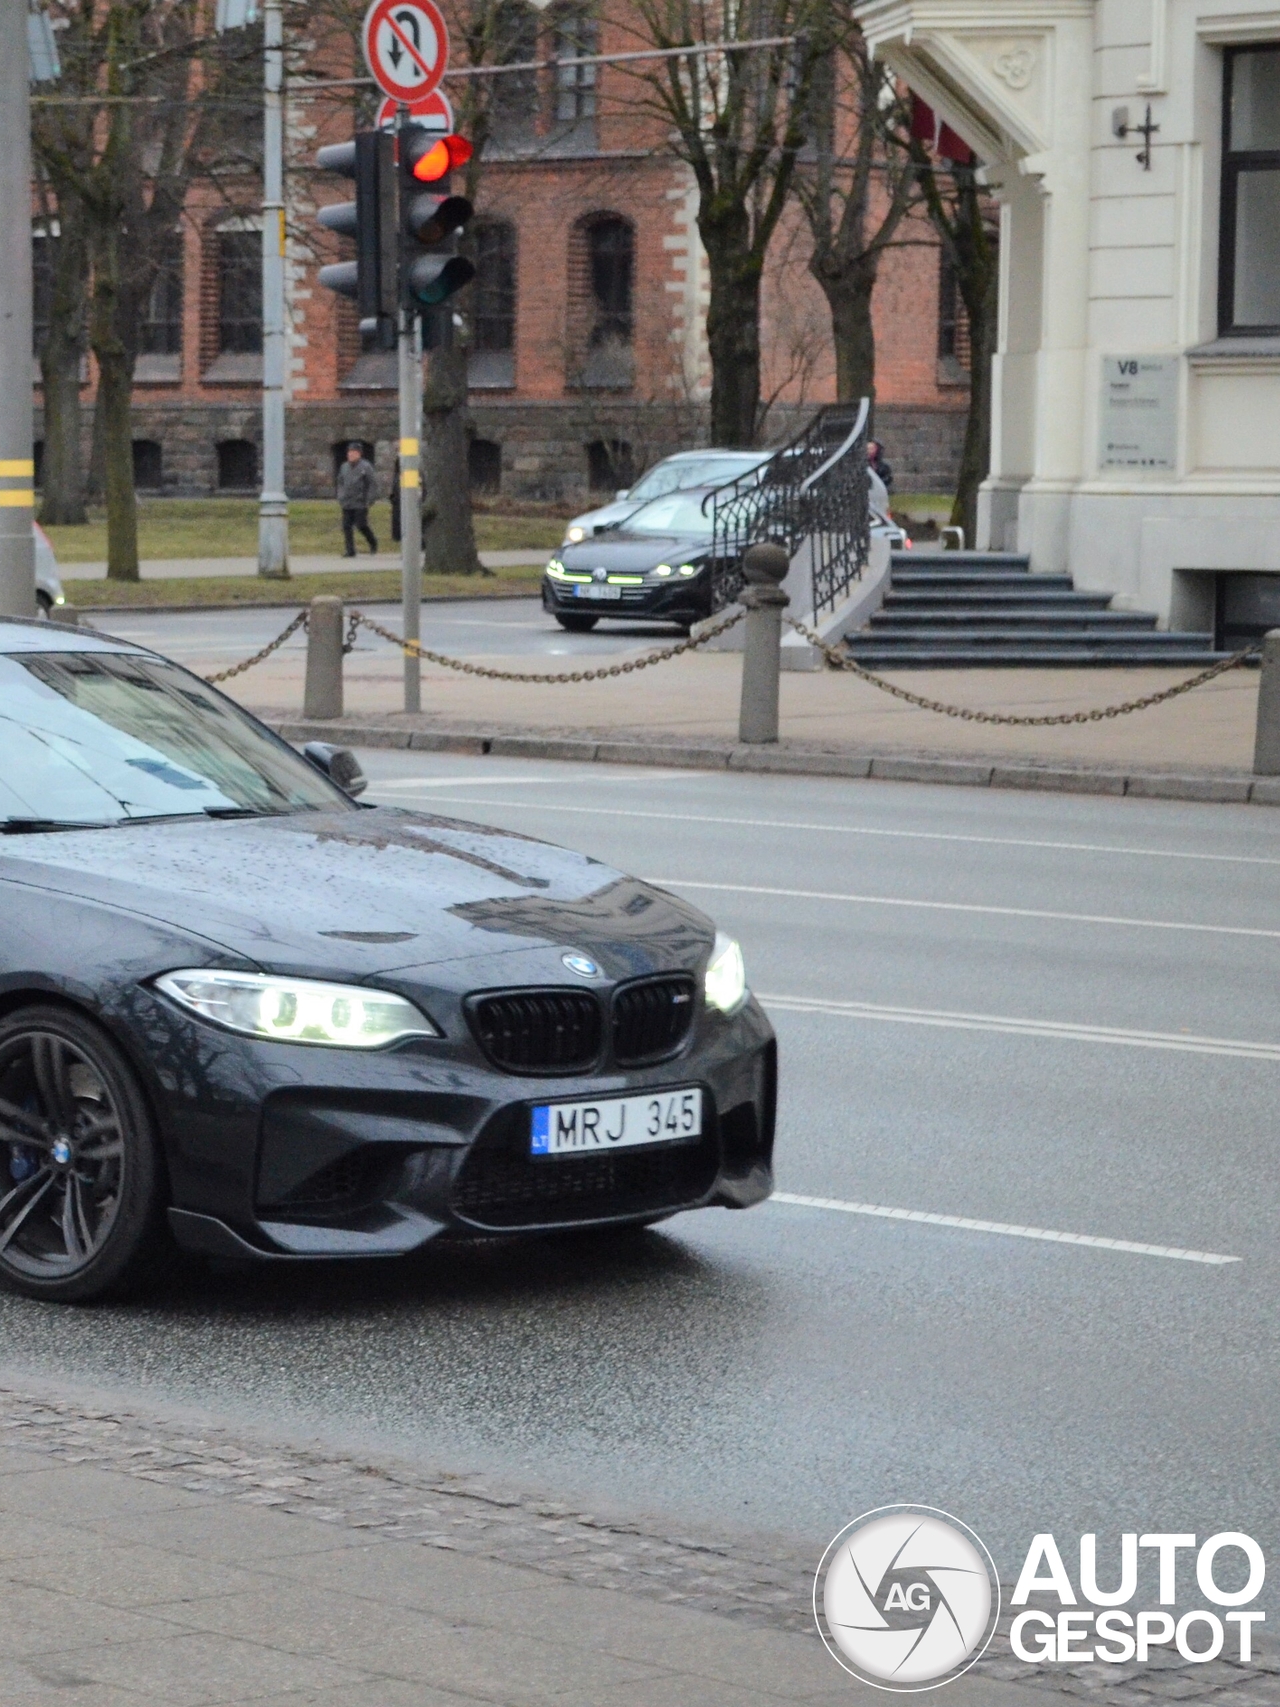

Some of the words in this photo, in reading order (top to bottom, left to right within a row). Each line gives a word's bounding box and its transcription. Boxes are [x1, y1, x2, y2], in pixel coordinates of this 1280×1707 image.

[1118, 360, 1138, 375] V8
[556, 1104, 626, 1148] MRJ
[647, 1095, 694, 1137] 345
